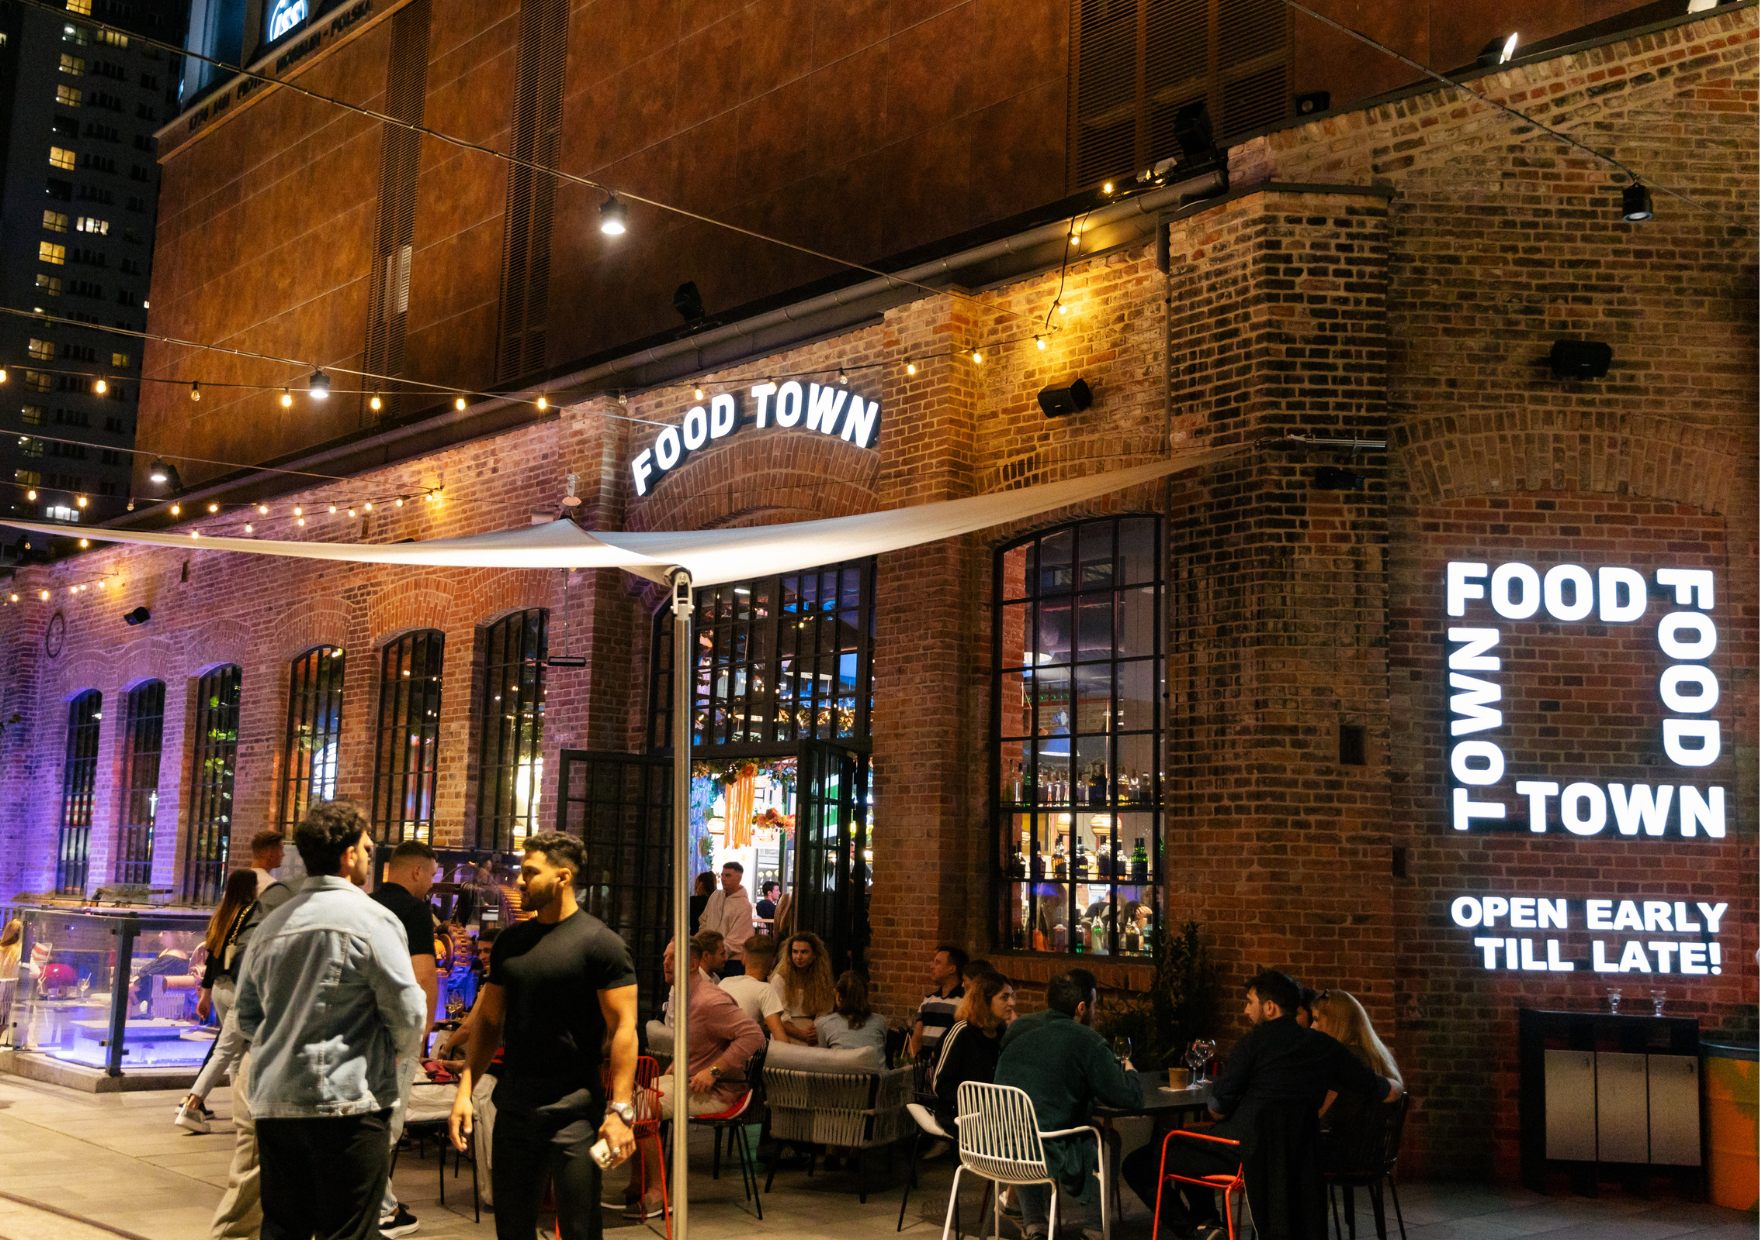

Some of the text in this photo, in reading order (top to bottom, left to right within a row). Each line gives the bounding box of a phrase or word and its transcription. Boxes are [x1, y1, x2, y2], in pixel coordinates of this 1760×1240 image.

[631, 381, 879, 497] FOOD TOWN
[1447, 561, 1648, 622] FOOD
[1656, 568, 1721, 767] FOOD
[1447, 627, 1506, 831] TOWN
[1515, 780, 1726, 839] TOWN
[1450, 896, 1729, 933] OPEN EARLY
[1474, 937, 1722, 976] TILL LATE!
